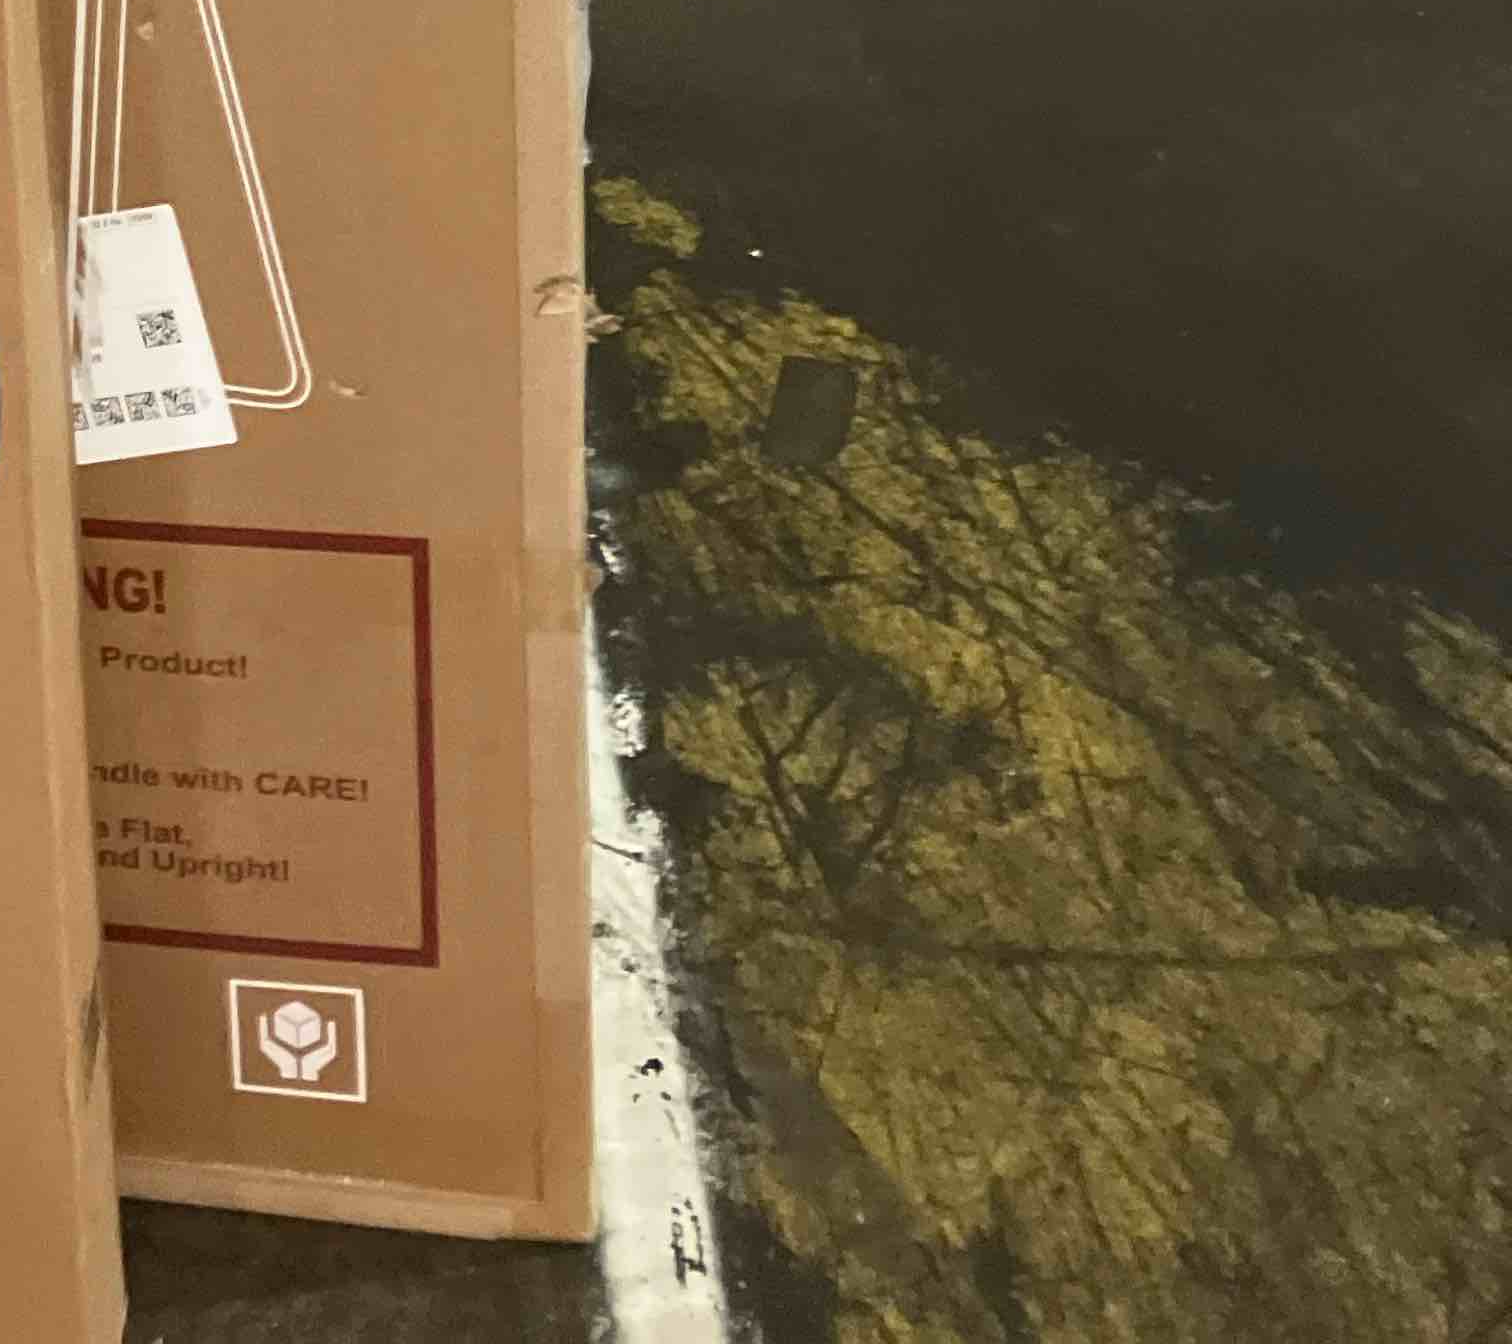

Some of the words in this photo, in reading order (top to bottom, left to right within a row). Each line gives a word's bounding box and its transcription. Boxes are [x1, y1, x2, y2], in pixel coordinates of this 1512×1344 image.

[99, 645, 248, 679] Product!
[92, 762, 161, 786] ndle
[169, 766, 244, 793] with
[254, 772, 369, 802] CARE!
[120, 817, 192, 848] Flat,
[151, 849, 290, 885] Upright!
